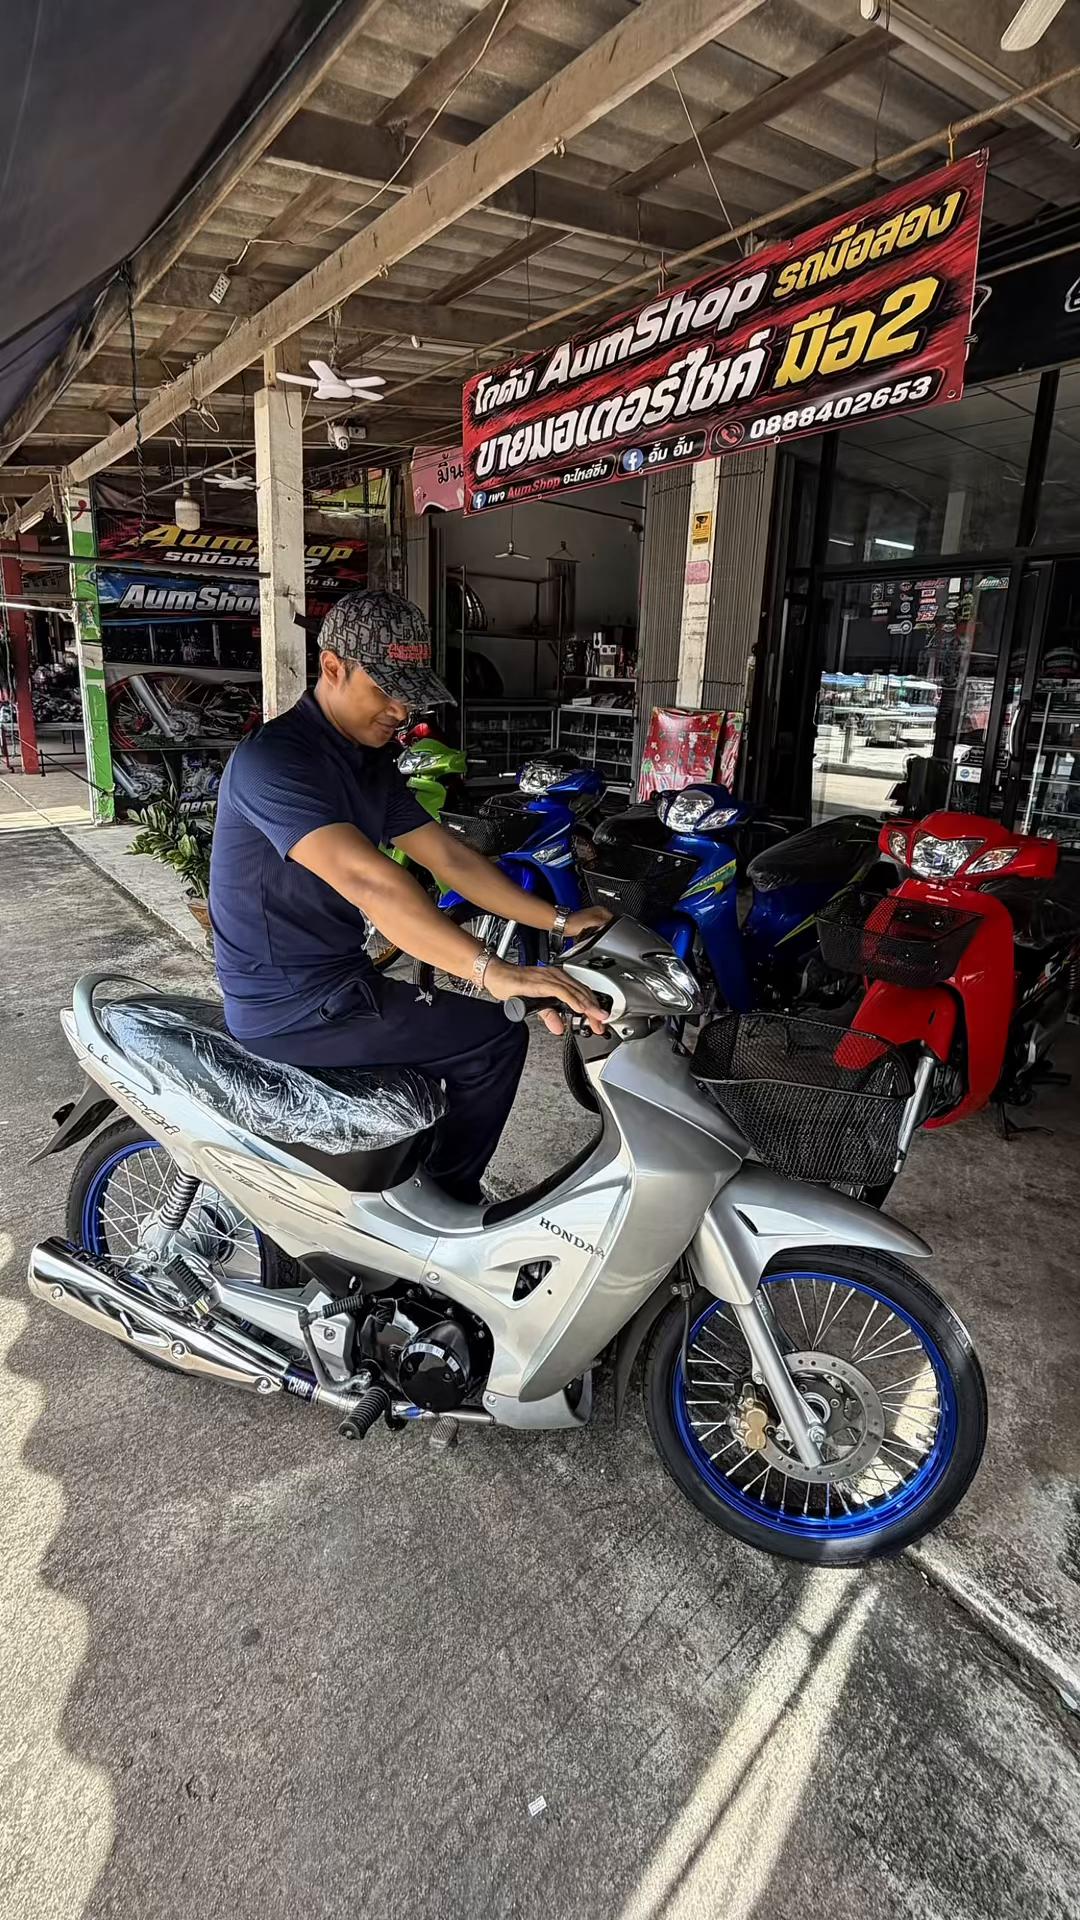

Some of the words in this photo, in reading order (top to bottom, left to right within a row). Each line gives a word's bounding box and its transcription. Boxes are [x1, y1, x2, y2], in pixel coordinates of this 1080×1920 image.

[475, 369, 535, 416] โกดัง
[537, 273, 768, 390] AumShop
[773, 191, 961, 298] รถมือสอง
[772, 276, 940, 389] มือ2
[750, 375, 932, 439] 0888402653
[507, 475, 561, 499] AumShop
[539, 1216, 596, 1255] HONDA
